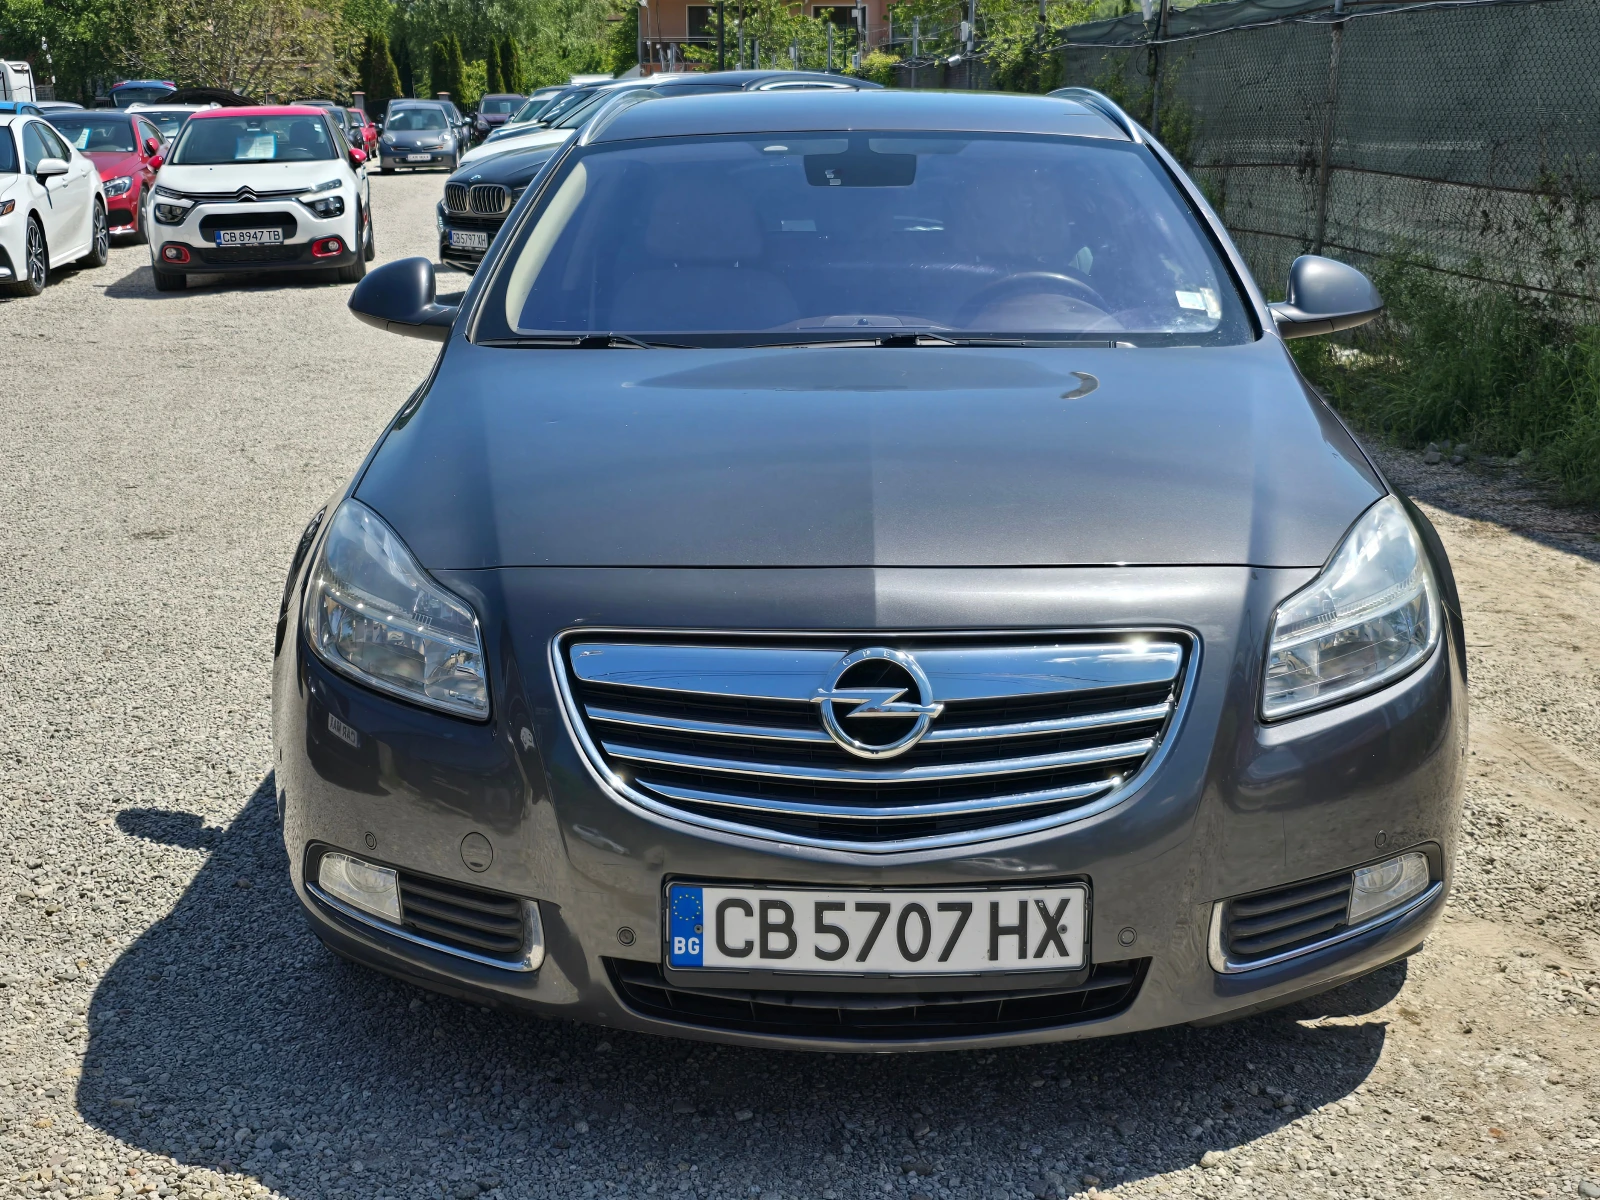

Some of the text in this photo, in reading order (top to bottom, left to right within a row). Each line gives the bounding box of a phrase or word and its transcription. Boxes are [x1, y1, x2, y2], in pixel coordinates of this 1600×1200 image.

[223, 230, 280, 242] CB 8947 TB
[453, 232, 486, 246] CB 5797 XH
[842, 649, 908, 667] OPEL
[715, 898, 1071, 963] CB 5707 HX
[673, 936, 701, 955] BG
